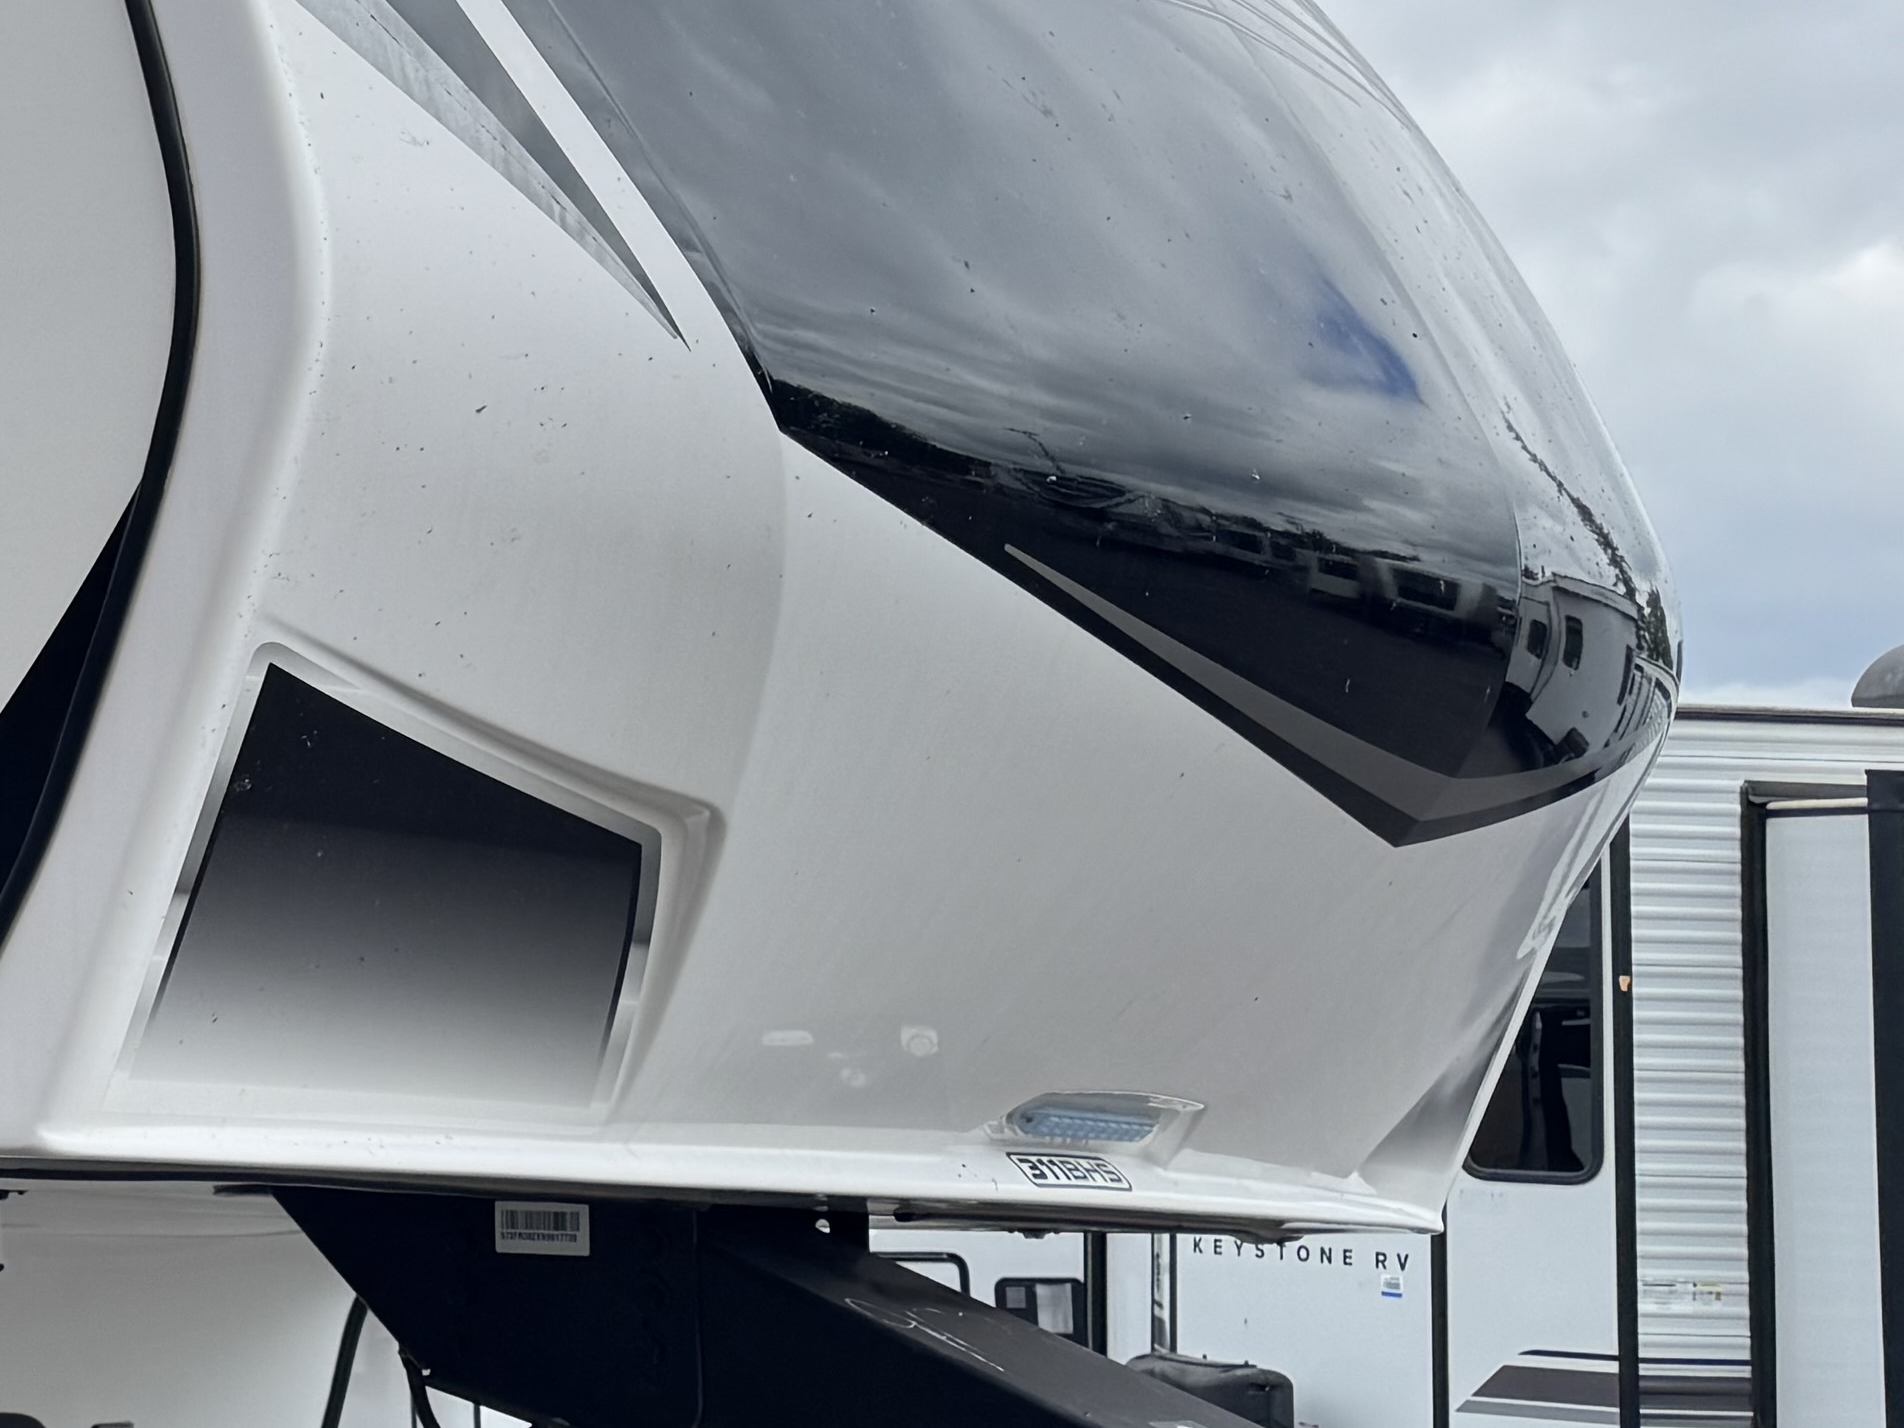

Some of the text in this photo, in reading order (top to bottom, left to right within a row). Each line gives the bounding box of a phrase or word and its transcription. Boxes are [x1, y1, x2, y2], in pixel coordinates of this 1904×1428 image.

[1015, 1157, 1124, 1184] 311BHS
[1193, 1236, 1409, 1272] KEYSTONE RV
